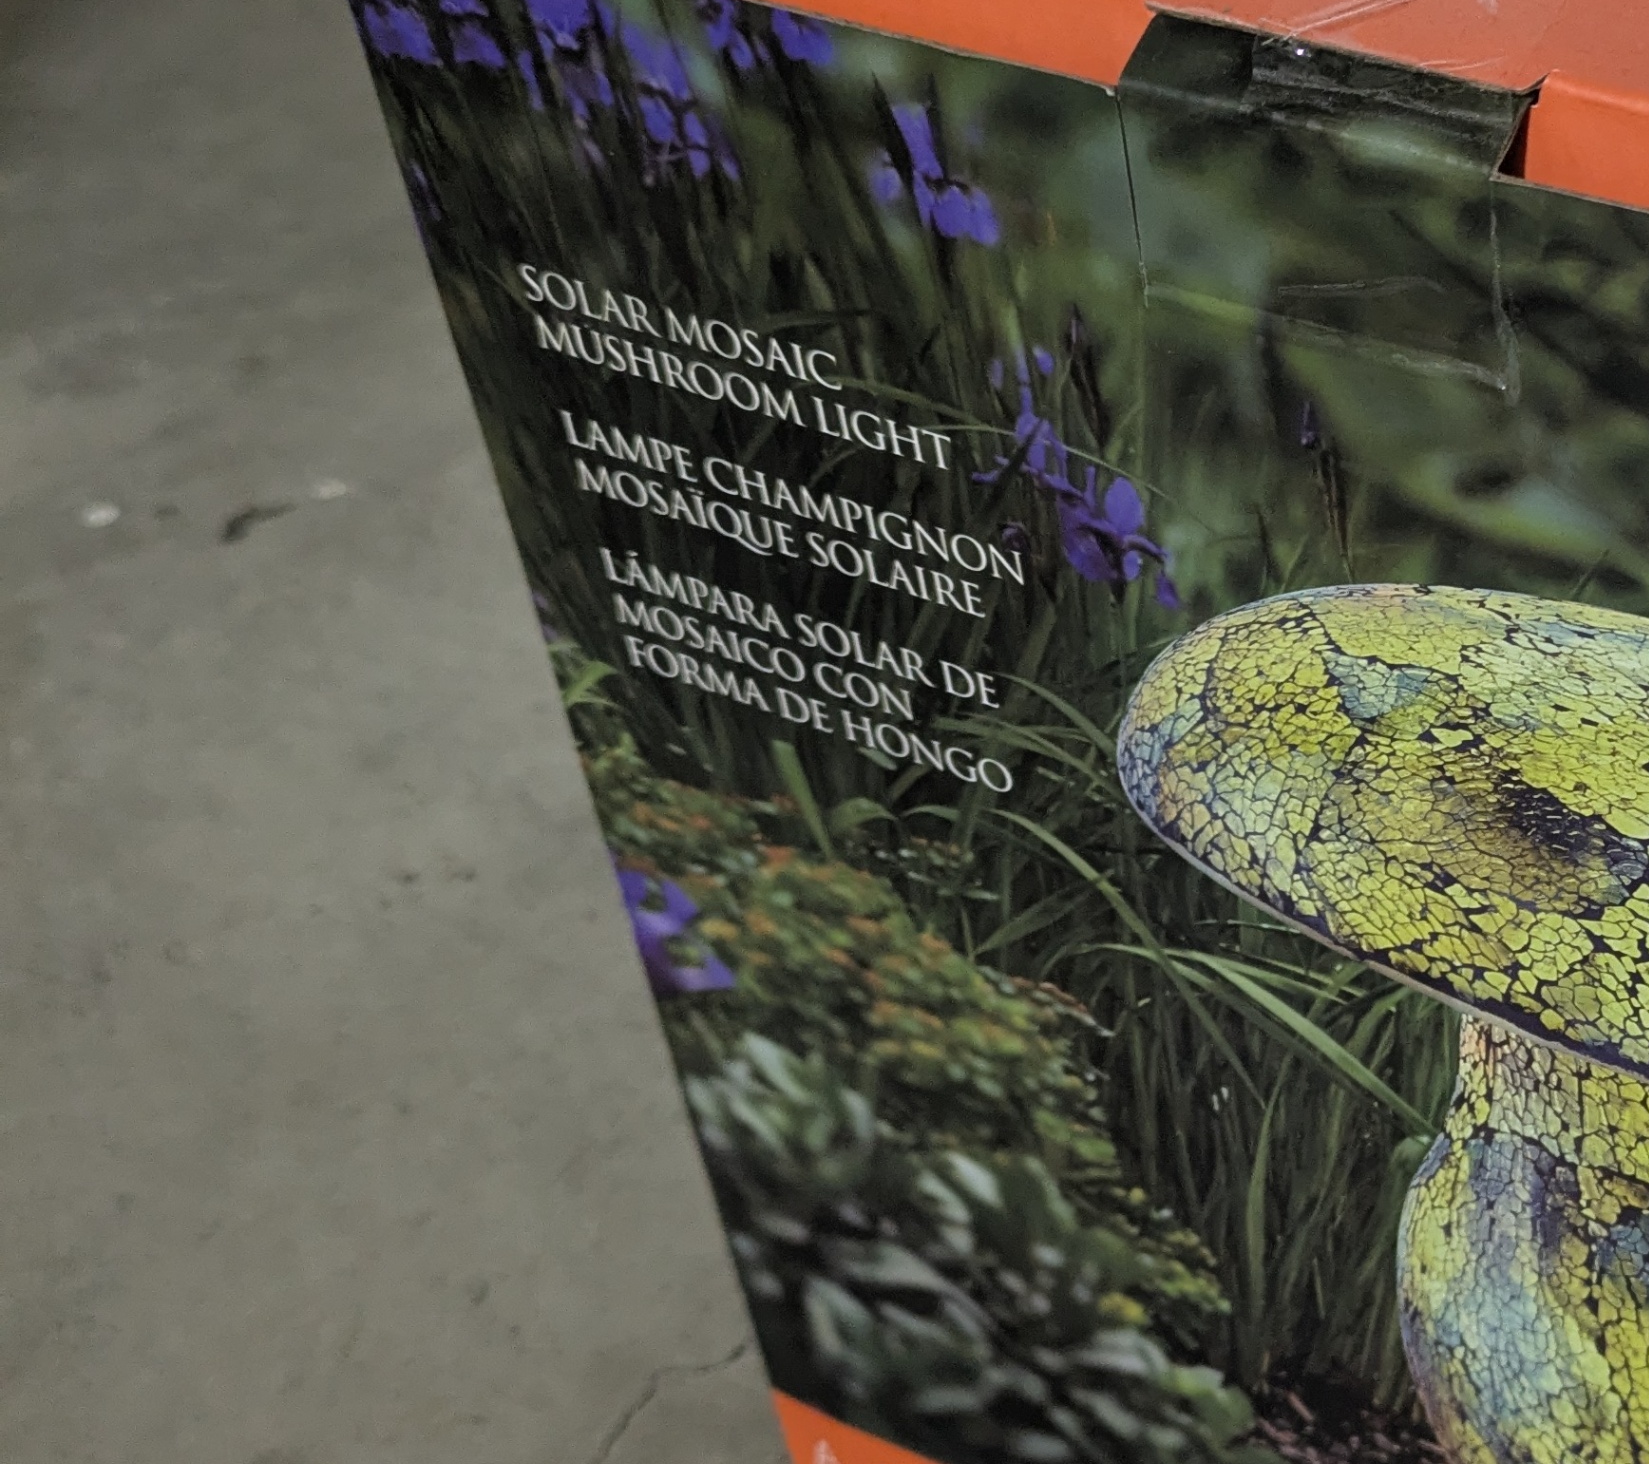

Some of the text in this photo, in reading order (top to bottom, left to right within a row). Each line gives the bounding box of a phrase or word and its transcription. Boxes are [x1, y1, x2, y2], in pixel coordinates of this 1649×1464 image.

[517, 263, 843, 391] SOLAR MOSAIC
[533, 314, 951, 471] MUSHROOM LIGHT
[560, 409, 1027, 586] LAMPE CHAMPIGNON
[575, 458, 985, 619] MOSAÏQUE SOLAIRE
[601, 546, 1000, 709] LÁMPARA SOLAR DE
[614, 592, 914, 721] MOSAICO CON
[626, 635, 1014, 793] FORMA DE HONGO
